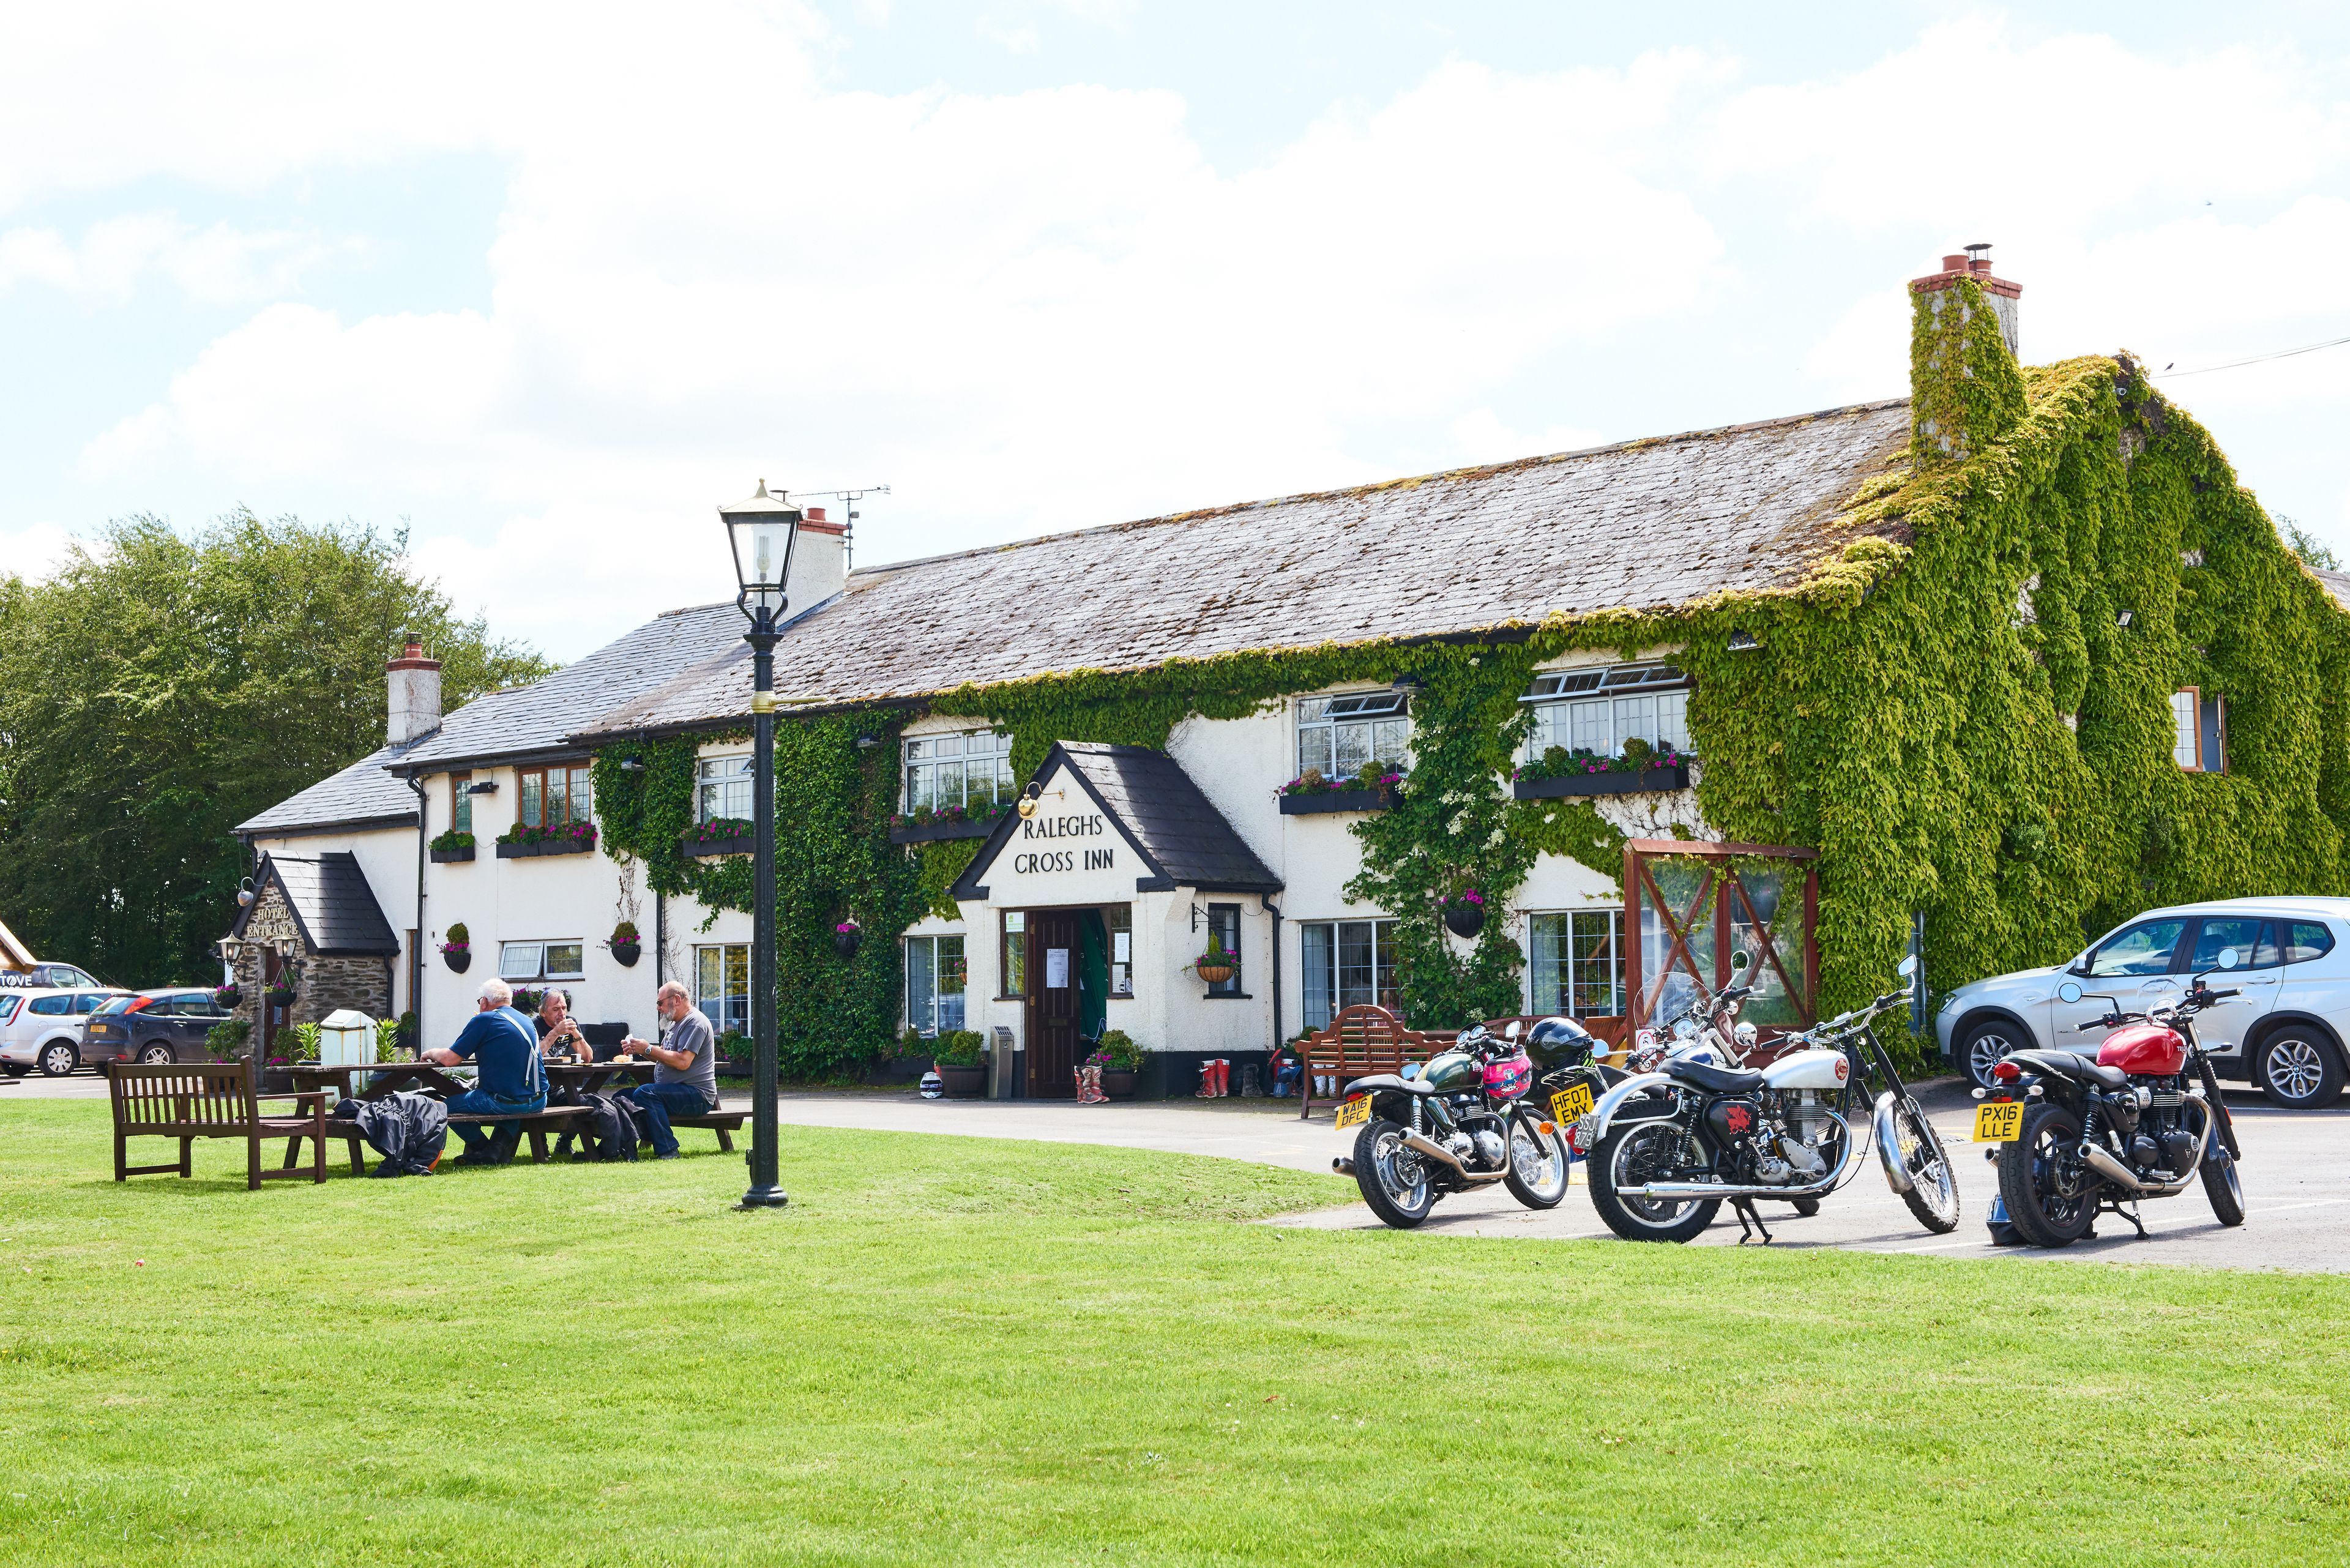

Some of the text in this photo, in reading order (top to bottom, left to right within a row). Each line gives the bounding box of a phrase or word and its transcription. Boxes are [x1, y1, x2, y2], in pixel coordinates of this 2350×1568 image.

[1024, 815, 1102, 839] RALEGHS
[1015, 849, 1113, 873] CROSS INN
[258, 907, 289, 920] HOTEL
[247, 924, 299, 937] ENTRANCE
[1343, 1097, 1368, 1116] WA16
[1553, 1086, 1587, 1111] HF07
[1341, 1110, 1364, 1126] DFC
[1561, 1103, 1589, 1124] EMX
[1981, 1105, 2018, 1122] PX16
[1578, 1115, 1597, 1131] SSJ
[1982, 1122, 2013, 1138] LLE
[1574, 1131, 1593, 1147] 879
